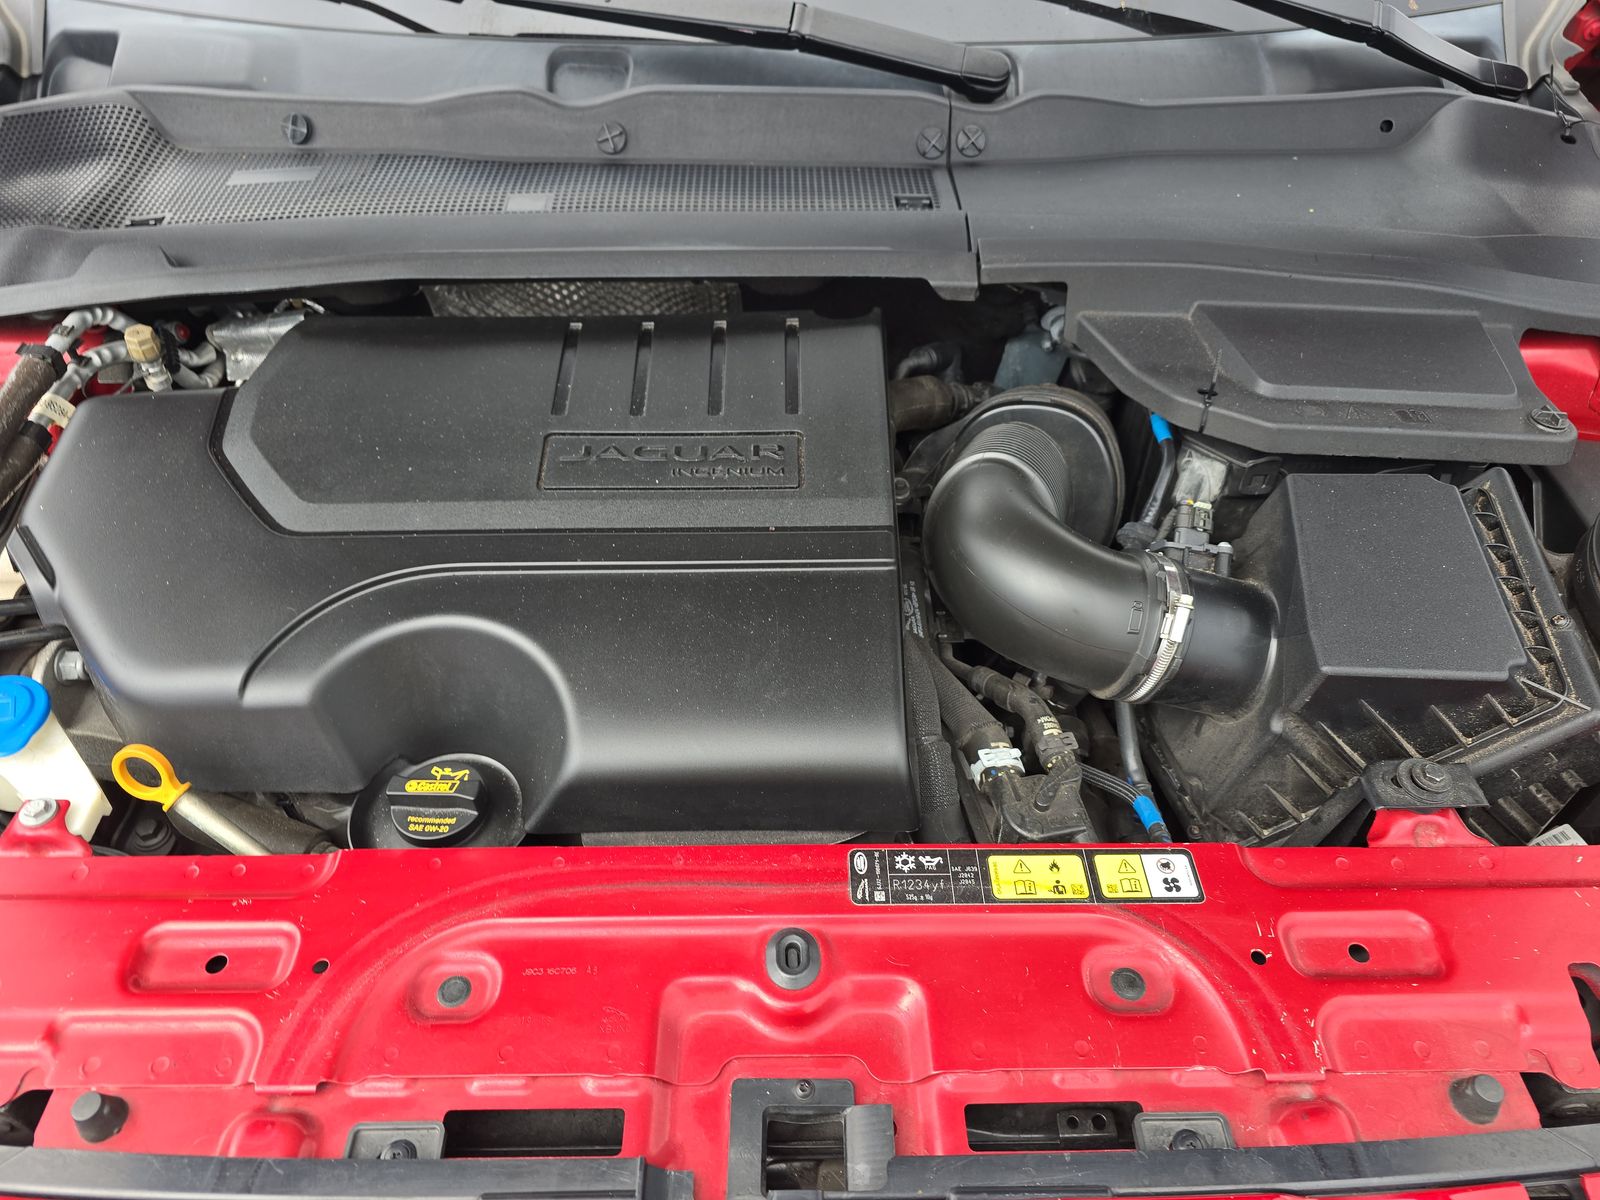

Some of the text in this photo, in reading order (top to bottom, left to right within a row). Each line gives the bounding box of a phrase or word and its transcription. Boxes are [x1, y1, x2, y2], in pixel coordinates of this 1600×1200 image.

[559, 443, 785, 462] JAGUAR
[671, 465, 786, 478] INGENIUM
[408, 816, 457, 824] recommended
[408, 823, 449, 833] SAE 0W-20
[892, 878, 944, 892] R1234yf
